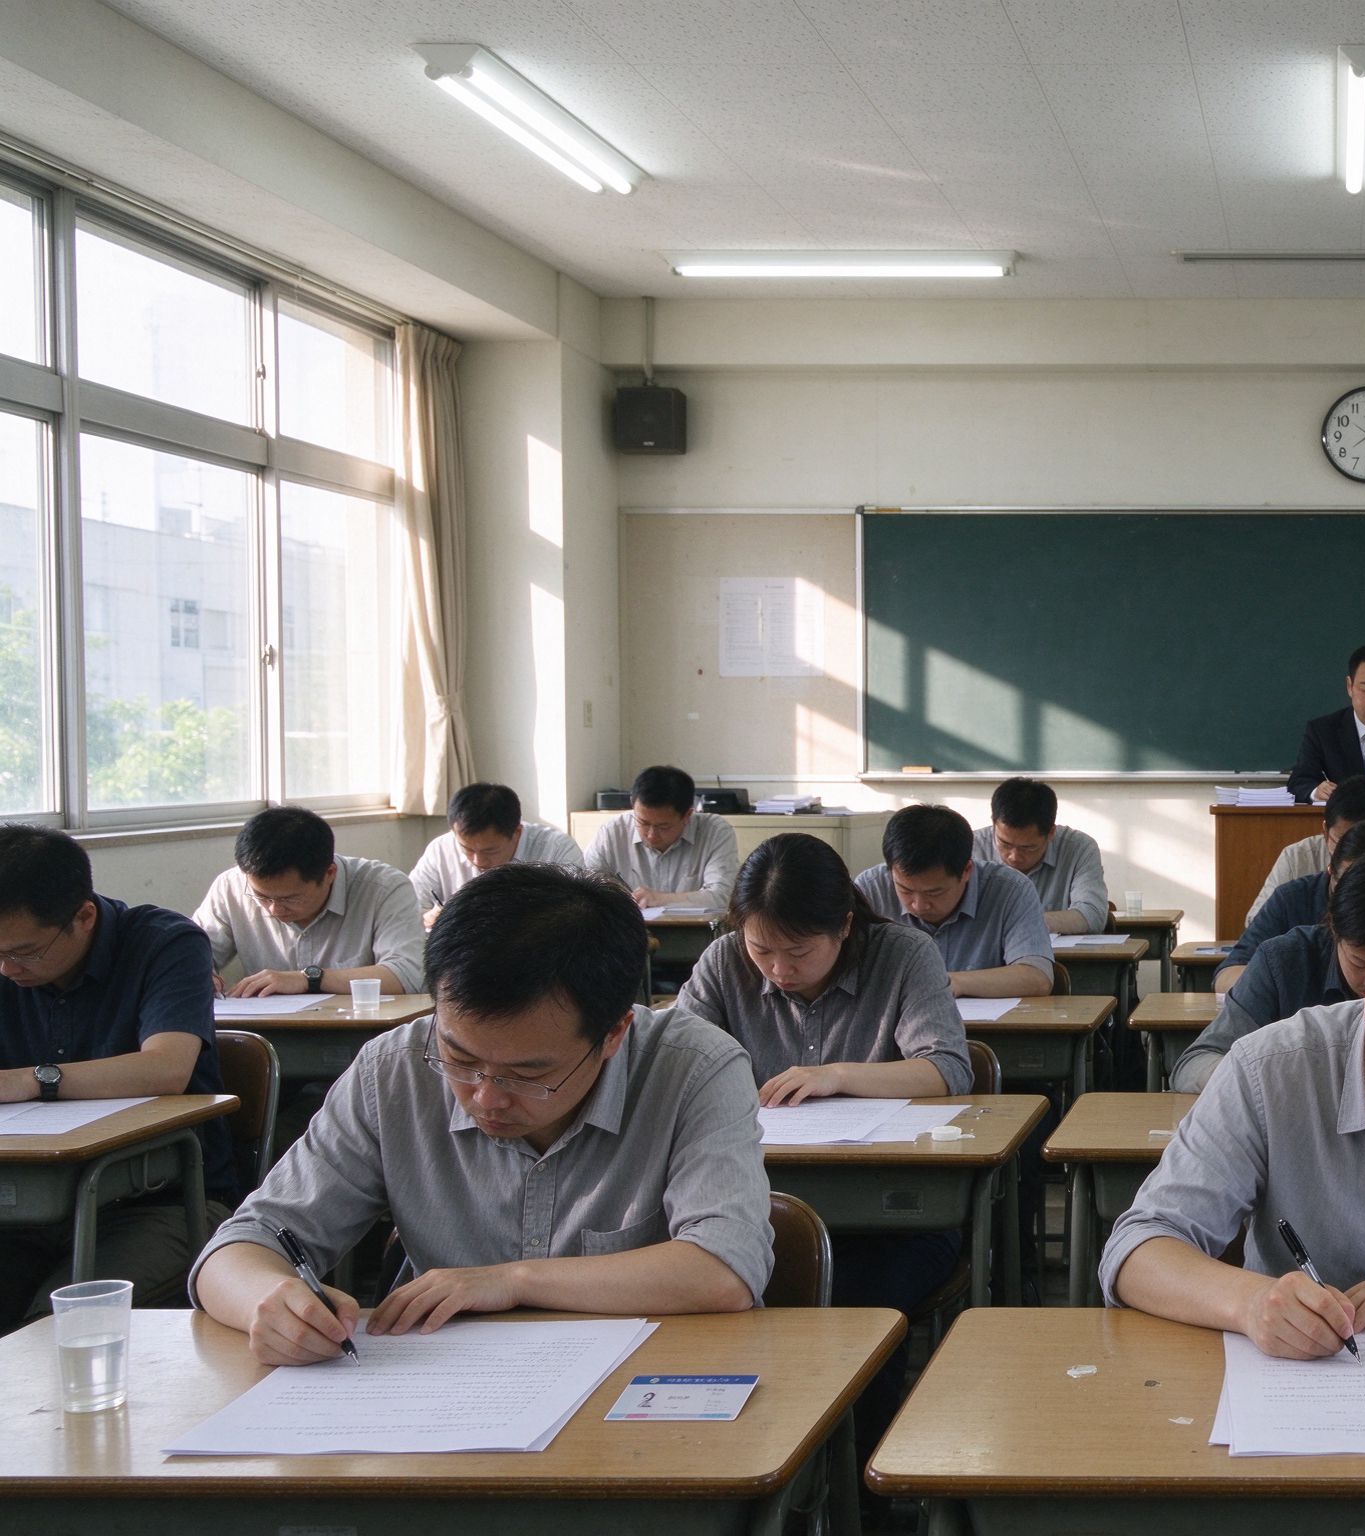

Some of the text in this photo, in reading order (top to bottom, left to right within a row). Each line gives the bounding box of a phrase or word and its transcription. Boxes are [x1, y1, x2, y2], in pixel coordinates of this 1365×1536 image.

[1352, 403, 1359, 414] 11
[1337, 415, 1350, 427] 10
[1334, 431, 1342, 442] 9
[1339, 447, 1346, 458] 8
[1352, 457, 1360, 470] 7
[637, 1392, 656, 1408] 2
